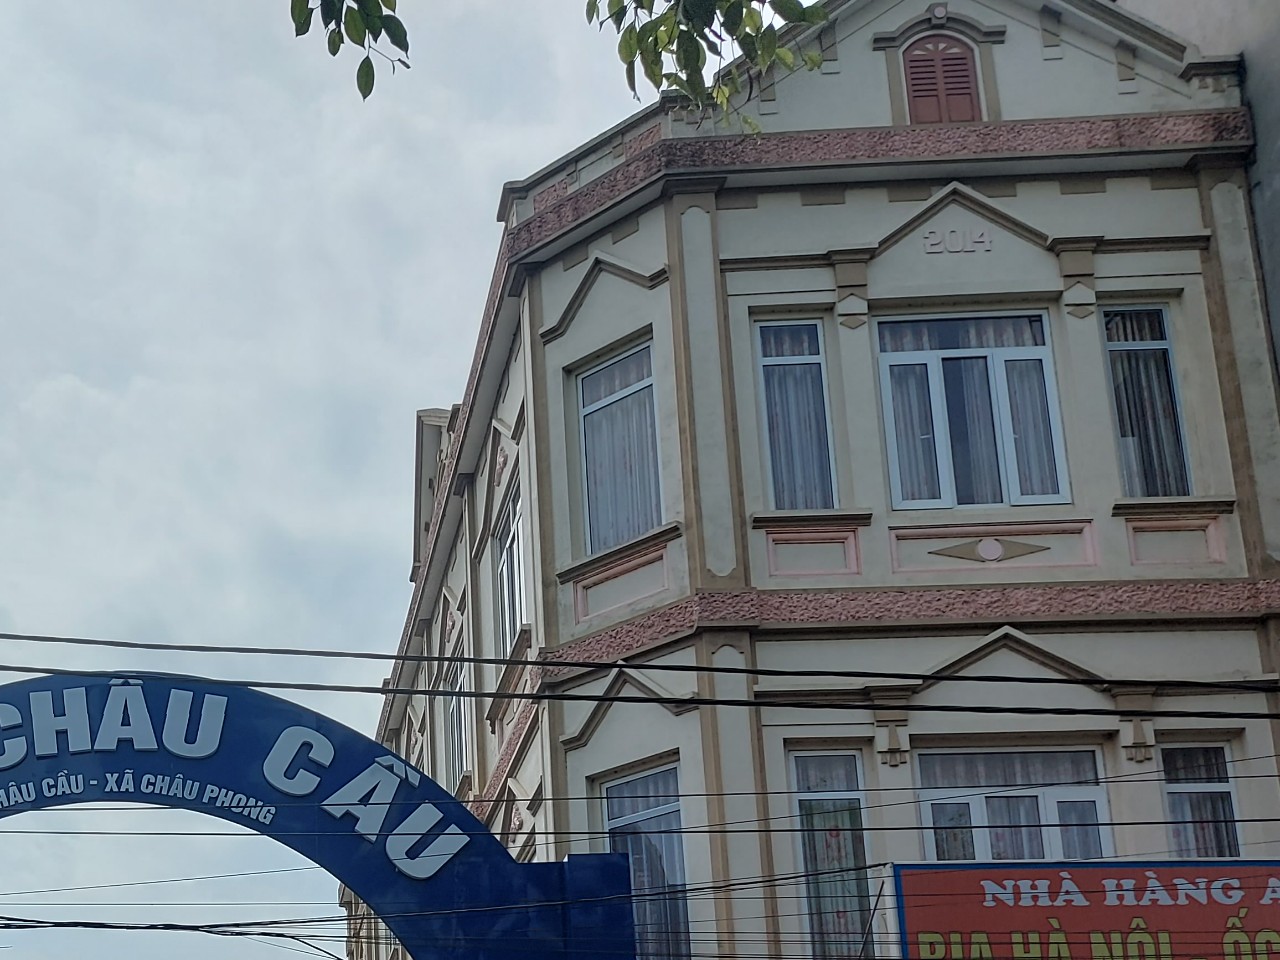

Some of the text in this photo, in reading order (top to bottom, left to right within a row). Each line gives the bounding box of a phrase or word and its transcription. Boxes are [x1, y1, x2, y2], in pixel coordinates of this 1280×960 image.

[923, 230, 993, 255] 2014
[41, 769, 85, 797] CẦU
[104, 769, 135, 793] XÃ
[140, 773, 201, 801] CHÂU
[202, 784, 276, 825] PHONG
[262, 725, 471, 881] CẦU
[980, 871, 1090, 907] NHÀ
[1101, 871, 1246, 907] HÀNG
